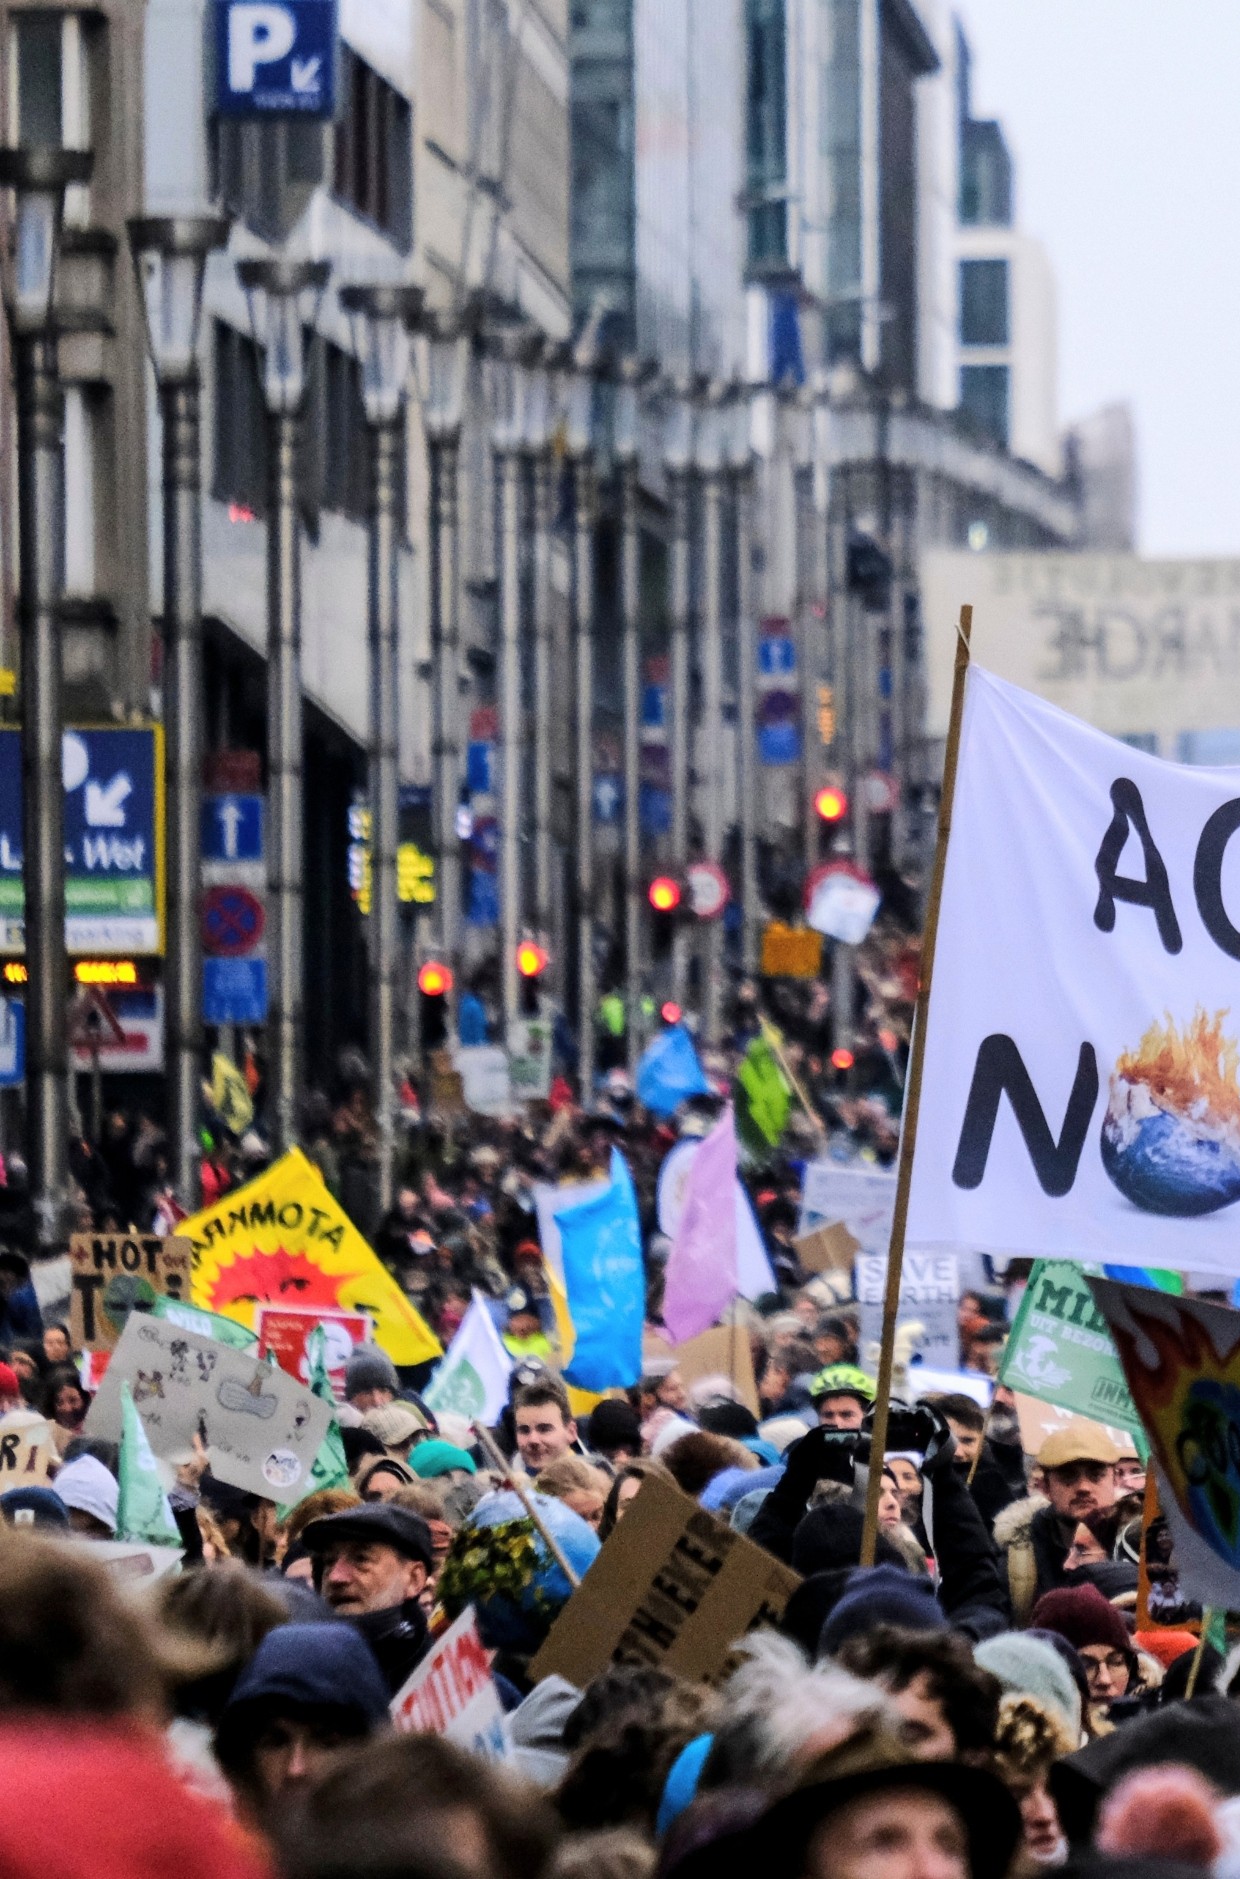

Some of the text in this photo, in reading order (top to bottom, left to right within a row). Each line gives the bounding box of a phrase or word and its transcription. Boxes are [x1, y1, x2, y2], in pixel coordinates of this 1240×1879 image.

[228, 4, 297, 93] P
[92, 1240, 162, 1273] HOT
[864, 1257, 953, 1283] SVE
[865, 1286, 953, 1304] ERTH
